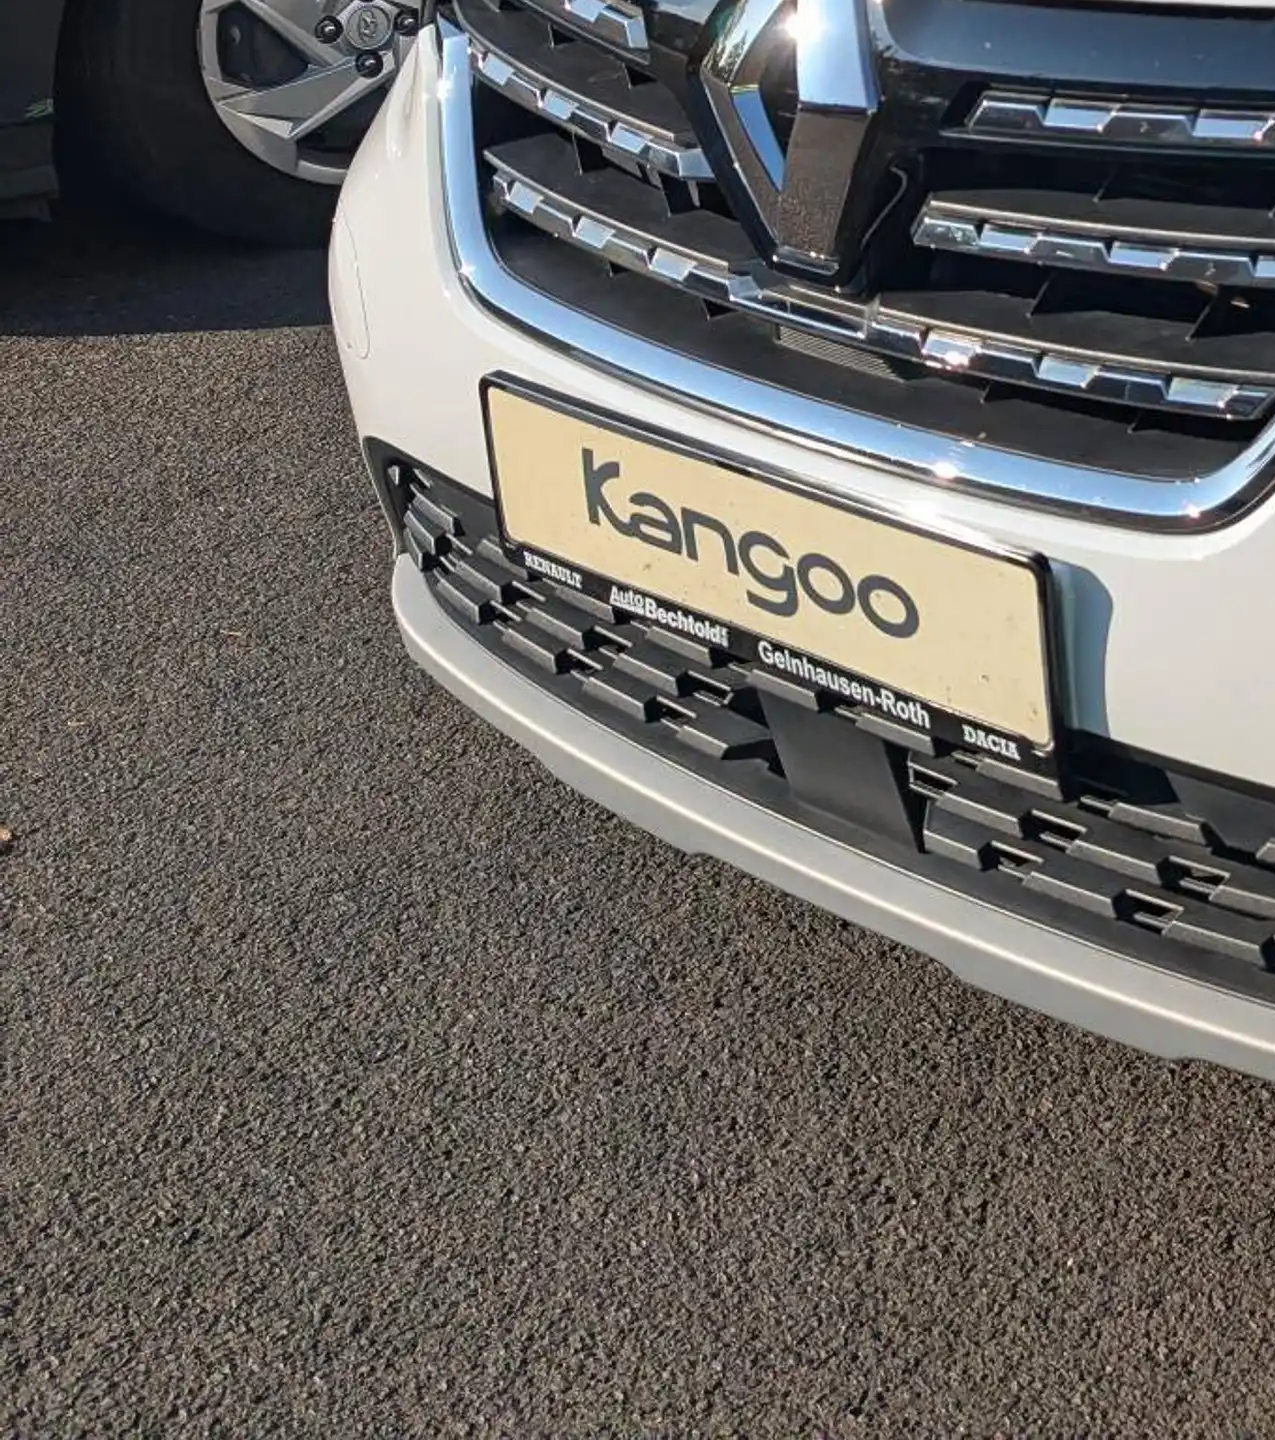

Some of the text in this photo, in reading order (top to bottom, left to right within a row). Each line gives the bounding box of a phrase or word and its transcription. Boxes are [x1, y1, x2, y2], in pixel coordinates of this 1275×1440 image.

[582, 447, 920, 638] Kangoo
[523, 551, 583, 589] RENAULT
[757, 641, 930, 729] Gelnhausen-Roth
[961, 724, 1021, 761] DACIA
